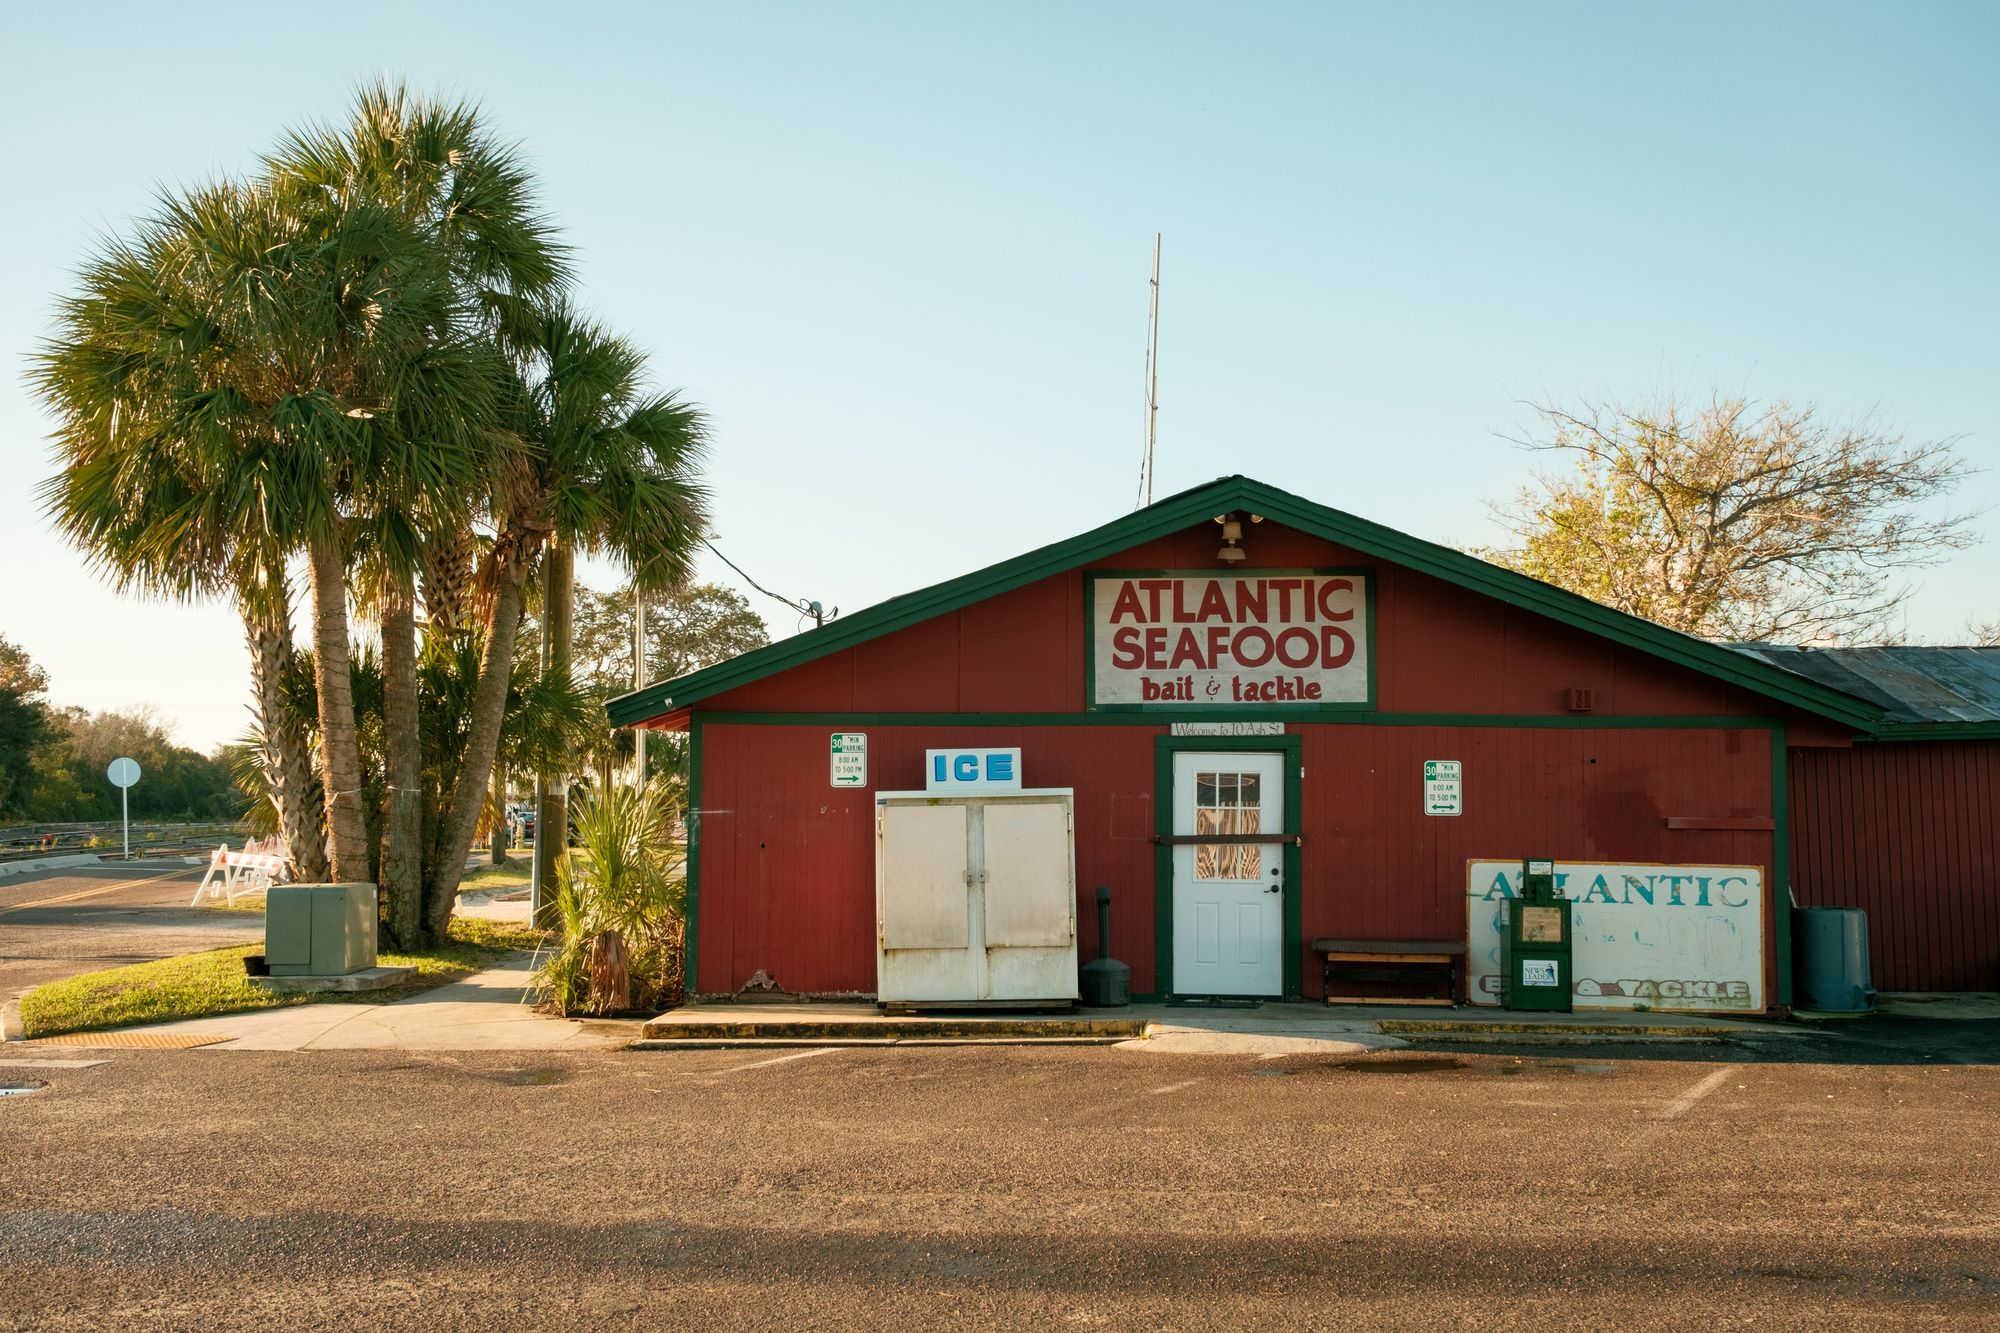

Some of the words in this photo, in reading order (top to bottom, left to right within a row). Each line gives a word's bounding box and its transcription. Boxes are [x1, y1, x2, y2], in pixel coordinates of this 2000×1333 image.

[1109, 579, 1354, 624] ATLANTIC
[1112, 626, 1355, 670] SEAFOOD
[1140, 675, 1195, 701] bait
[1206, 675, 1221, 701] &
[1232, 675, 1322, 701] tackle
[1176, 722, 1216, 736] Welcome
[1221, 723, 1228, 735] to
[1232, 722, 1244, 736] 10
[1247, 722, 1265, 736] Ash
[832, 739, 842, 749] 30
[851, 756, 859, 764] AM
[934, 754, 1014, 782] ICE
[1426, 766, 1436, 777] 30
[1482, 871, 1749, 908] ALANTIC
[1617, 978, 1751, 999] TACKLE
